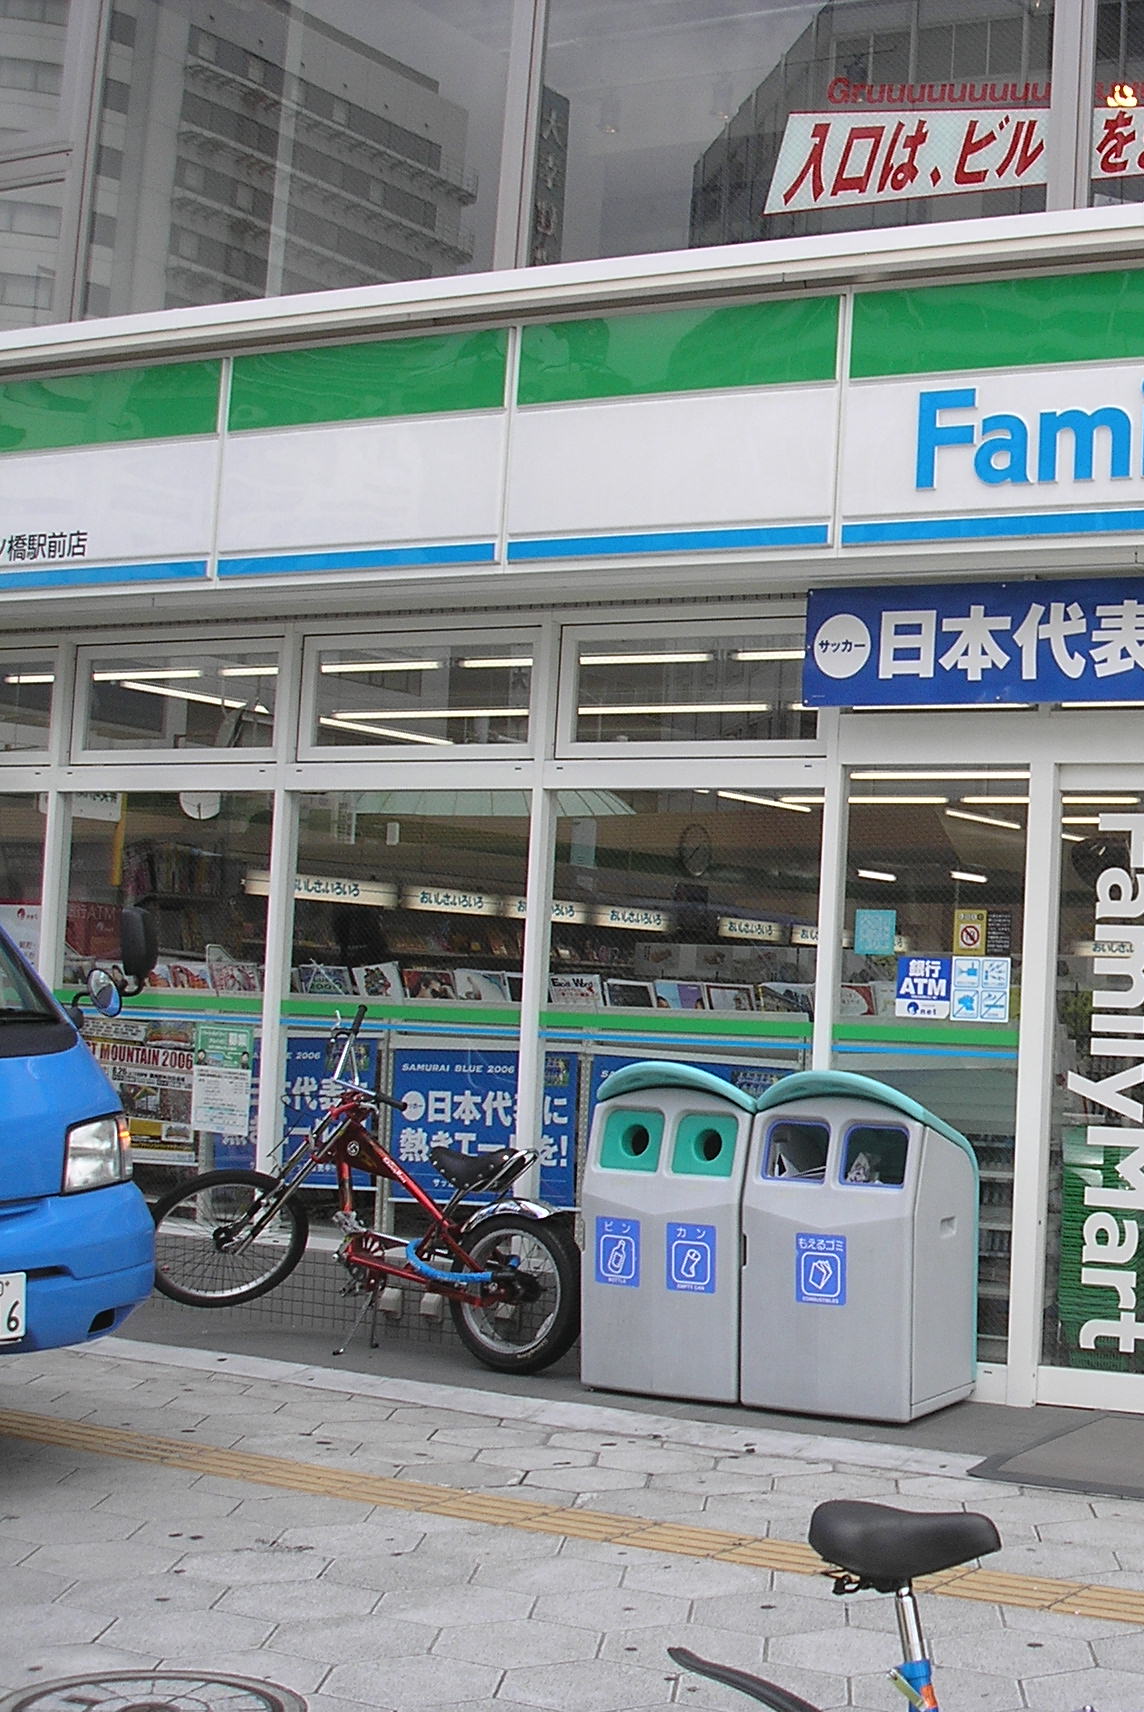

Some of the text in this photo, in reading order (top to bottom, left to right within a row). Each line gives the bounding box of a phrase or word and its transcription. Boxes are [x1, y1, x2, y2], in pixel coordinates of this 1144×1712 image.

[0, 530, 88, 561] 橋駅前店
[818, 639, 866, 653] サッカー
[909, 959, 942, 978] 銀行
[900, 977, 947, 996] ATM
[100, 1042, 160, 1066] MOUNTAIN
[161, 1050, 193, 1069] 2006
[401, 1063, 515, 1074] SAMURAI BLUE 2006
[427, 1090, 568, 1126] 日本代に
[604, 1220, 631, 1234] ビン
[676, 1227, 707, 1240] カン
[798, 1237, 844, 1253] もえるゴミ
